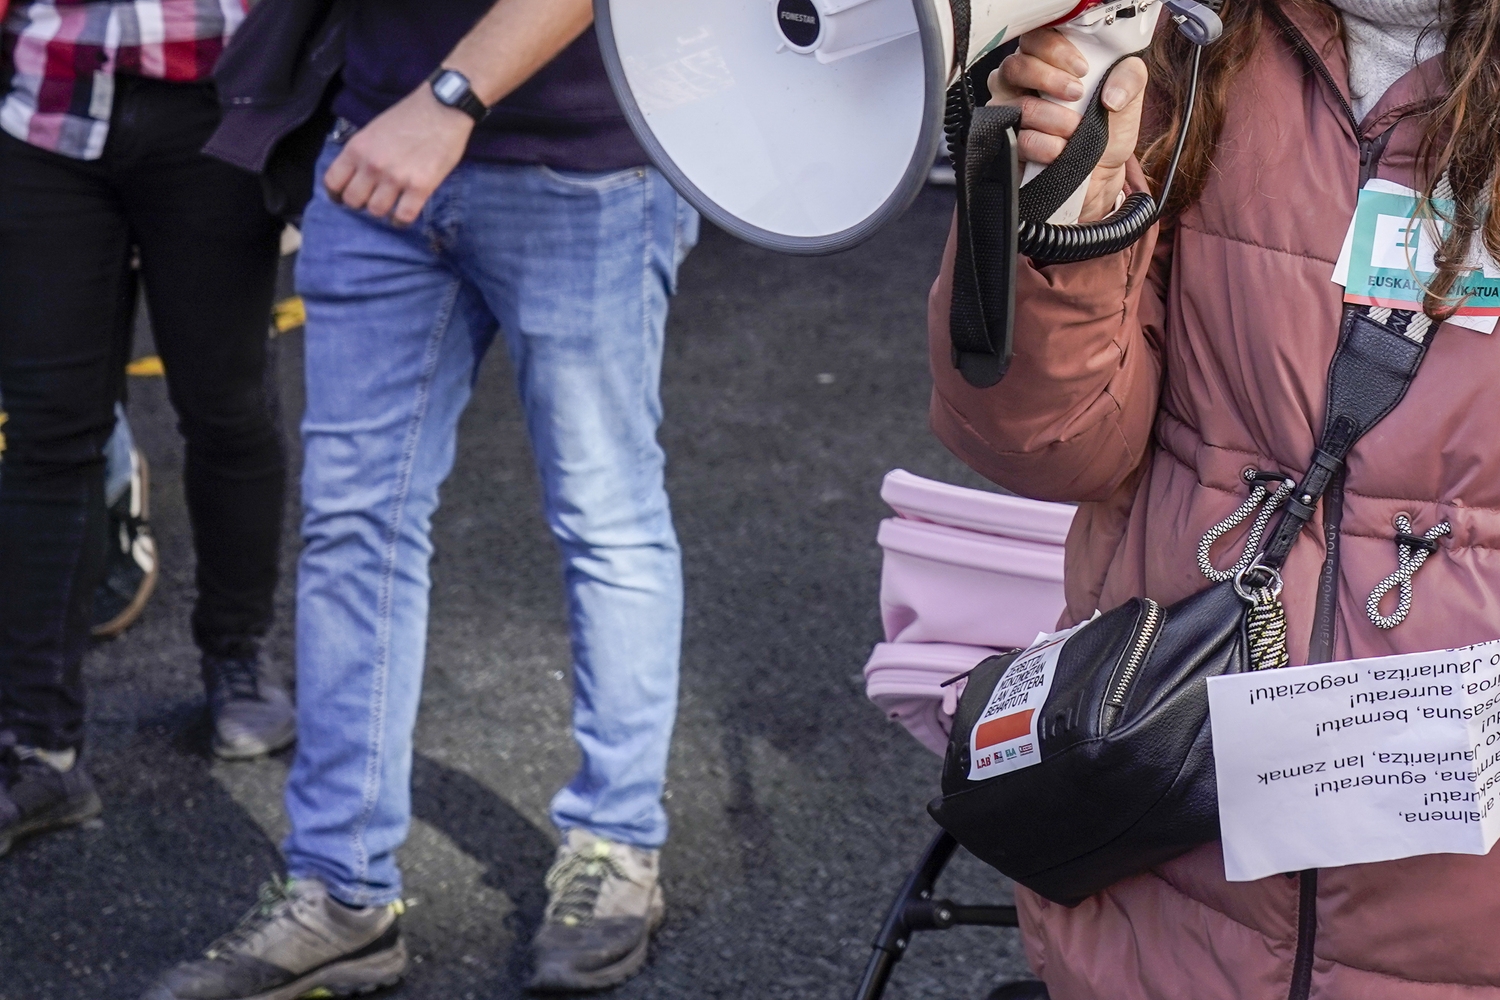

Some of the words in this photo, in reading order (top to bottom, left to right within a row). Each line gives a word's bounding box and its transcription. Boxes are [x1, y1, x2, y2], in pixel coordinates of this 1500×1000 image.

[1368, 275, 1419, 291] EUSKAL
[1367, 658, 1483, 682] Jaurlaritza,
[991, 689, 1010, 705] LAN
[1249, 673, 1359, 705] negoziatu!
[1350, 684, 1453, 709] aurreratu!
[1315, 709, 1408, 737] bermatu!
[1334, 754, 1364, 769] lan
[1372, 743, 1481, 767] Jaurlaritza,
[1256, 761, 1327, 786] zamak
[1314, 770, 1427, 797] eguneratu!
